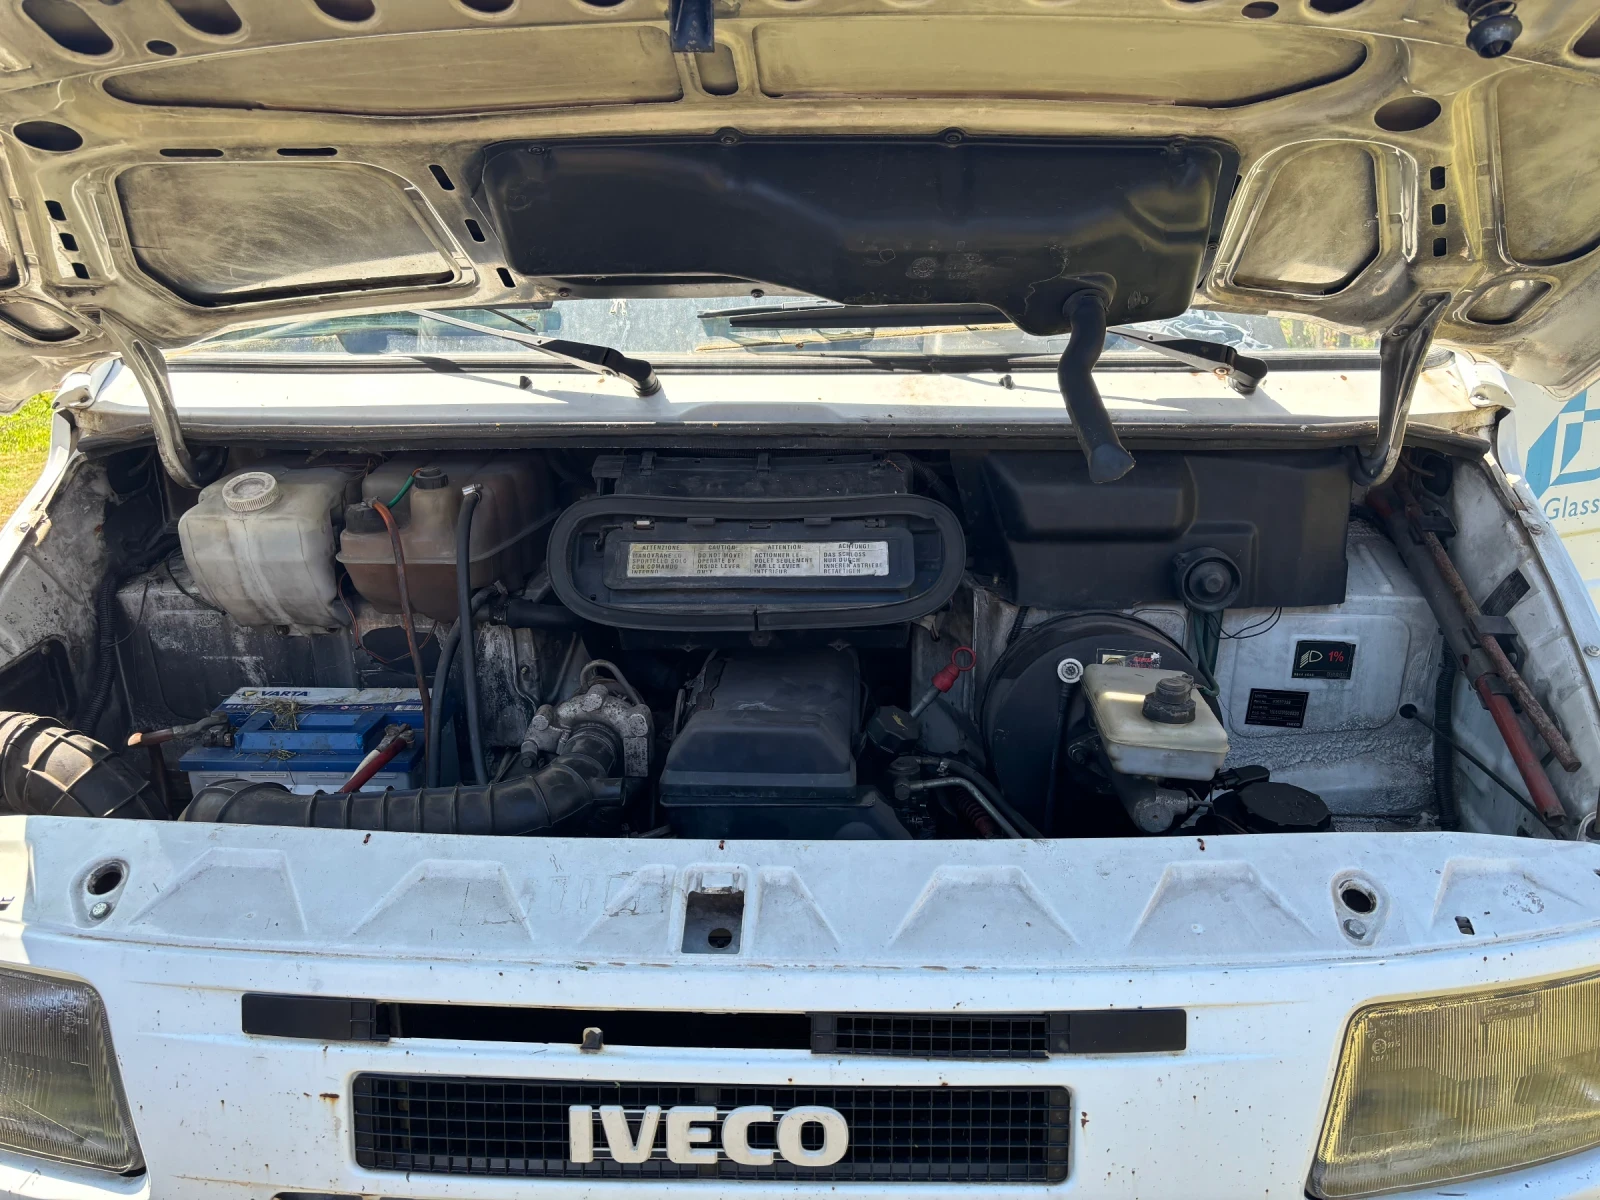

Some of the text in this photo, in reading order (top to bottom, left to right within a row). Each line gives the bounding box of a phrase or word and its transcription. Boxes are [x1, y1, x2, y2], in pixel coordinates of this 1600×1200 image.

[1544, 496, 1599, 520] Glass
[1328, 651, 1344, 662] 1%
[568, 1104, 849, 1167] IVECO
